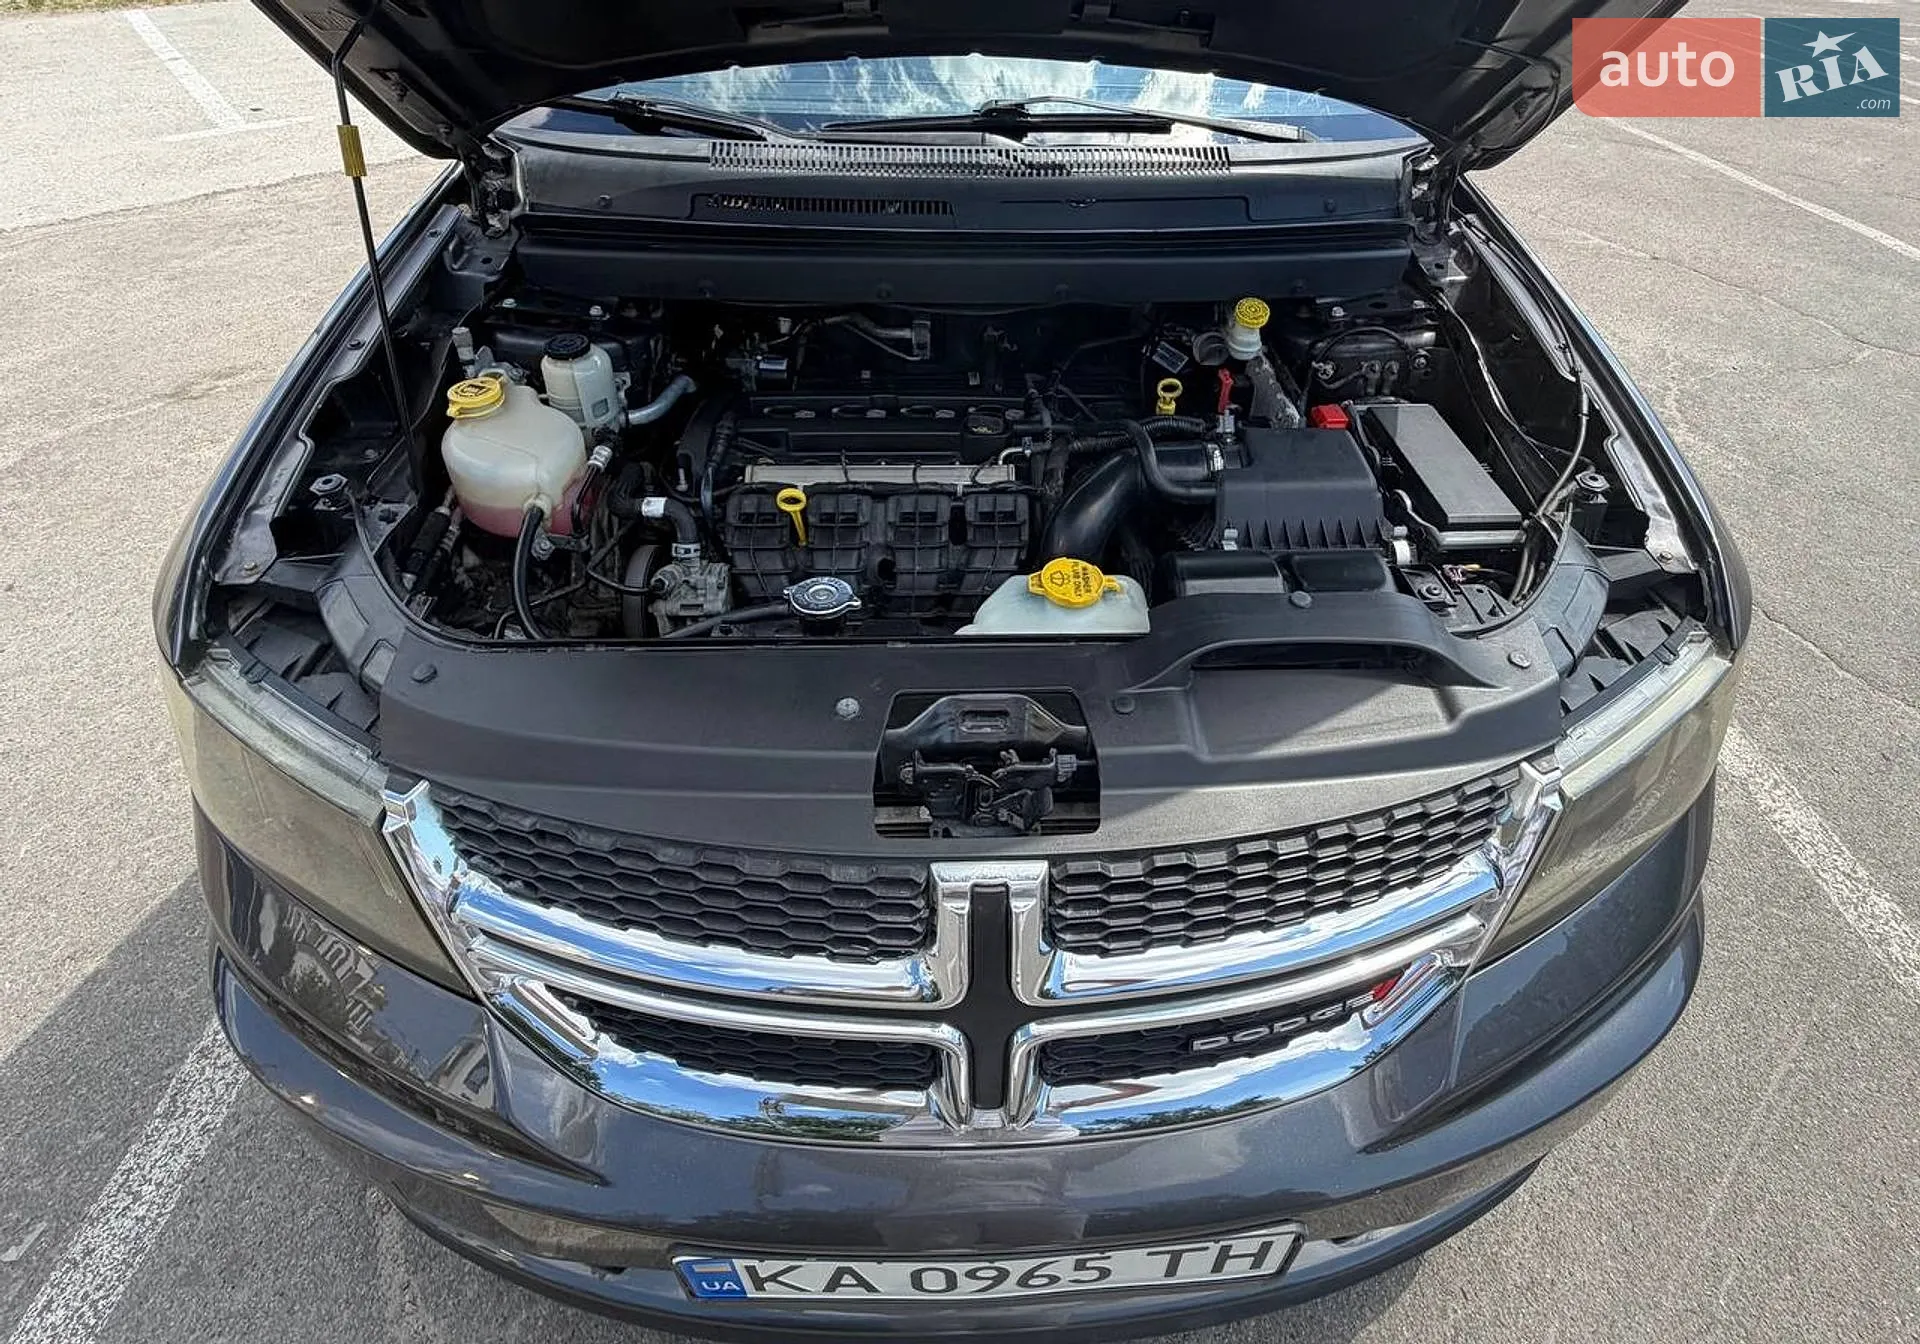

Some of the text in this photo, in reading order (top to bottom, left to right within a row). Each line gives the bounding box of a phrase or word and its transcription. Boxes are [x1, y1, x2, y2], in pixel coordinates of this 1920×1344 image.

[1192, 991, 1374, 1051] DODGE
[702, 1281, 740, 1291] UA
[744, 1240, 1278, 1293] KA 0965 TH
